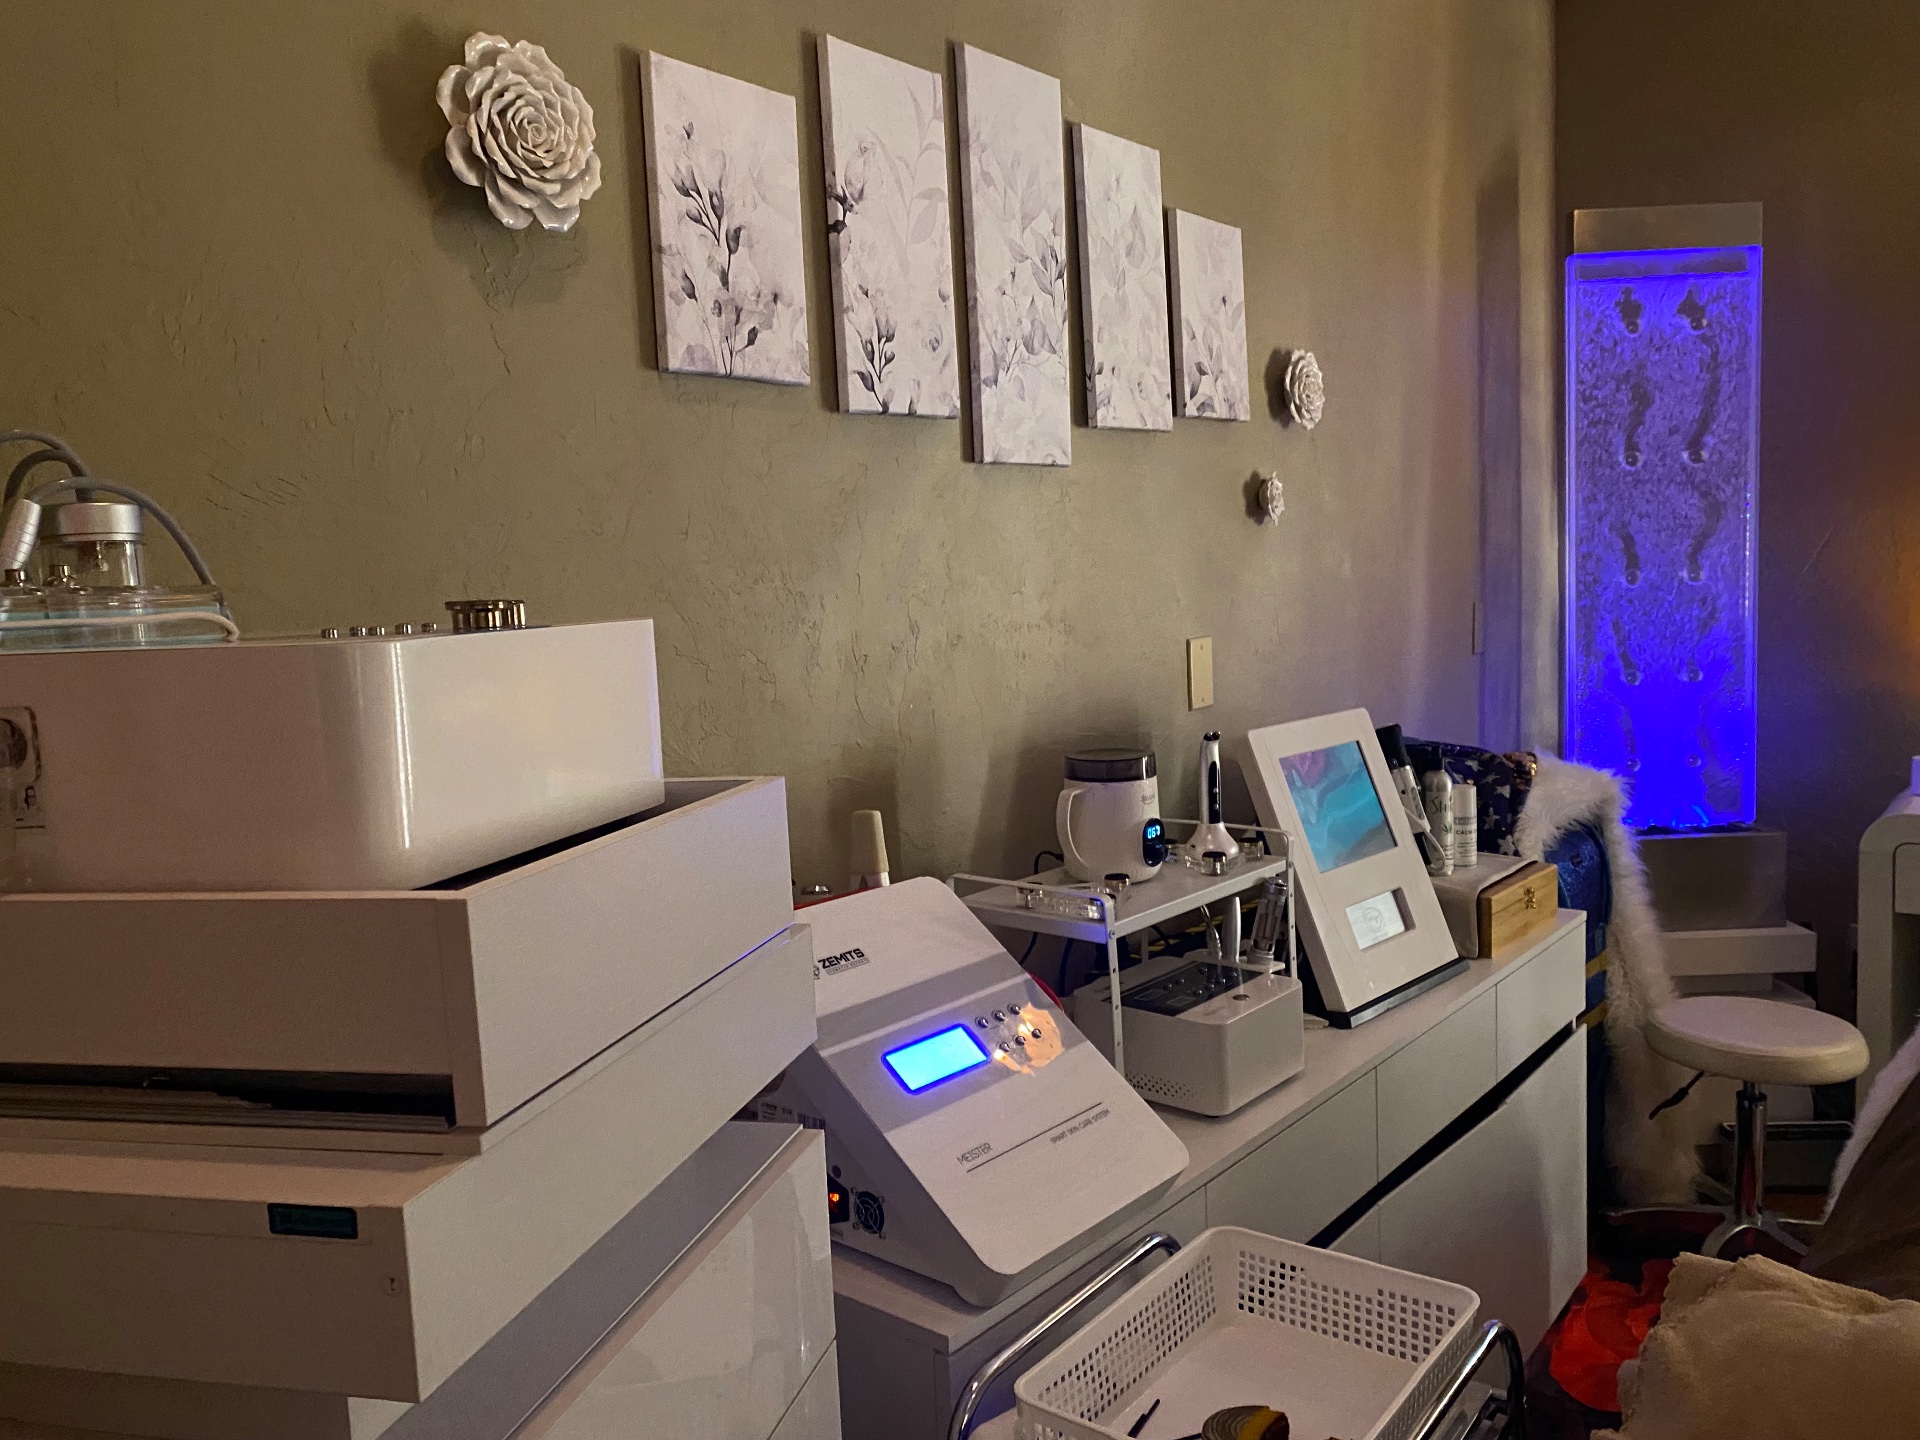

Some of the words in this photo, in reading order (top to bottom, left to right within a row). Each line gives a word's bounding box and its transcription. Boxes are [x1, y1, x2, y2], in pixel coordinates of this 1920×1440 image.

[817, 948, 865, 969] ZEMITS
[1078, 1118, 1093, 1130] CARE
[1092, 1109, 1110, 1123] SYSTEM
[956, 1142, 993, 1165] MEISTER
